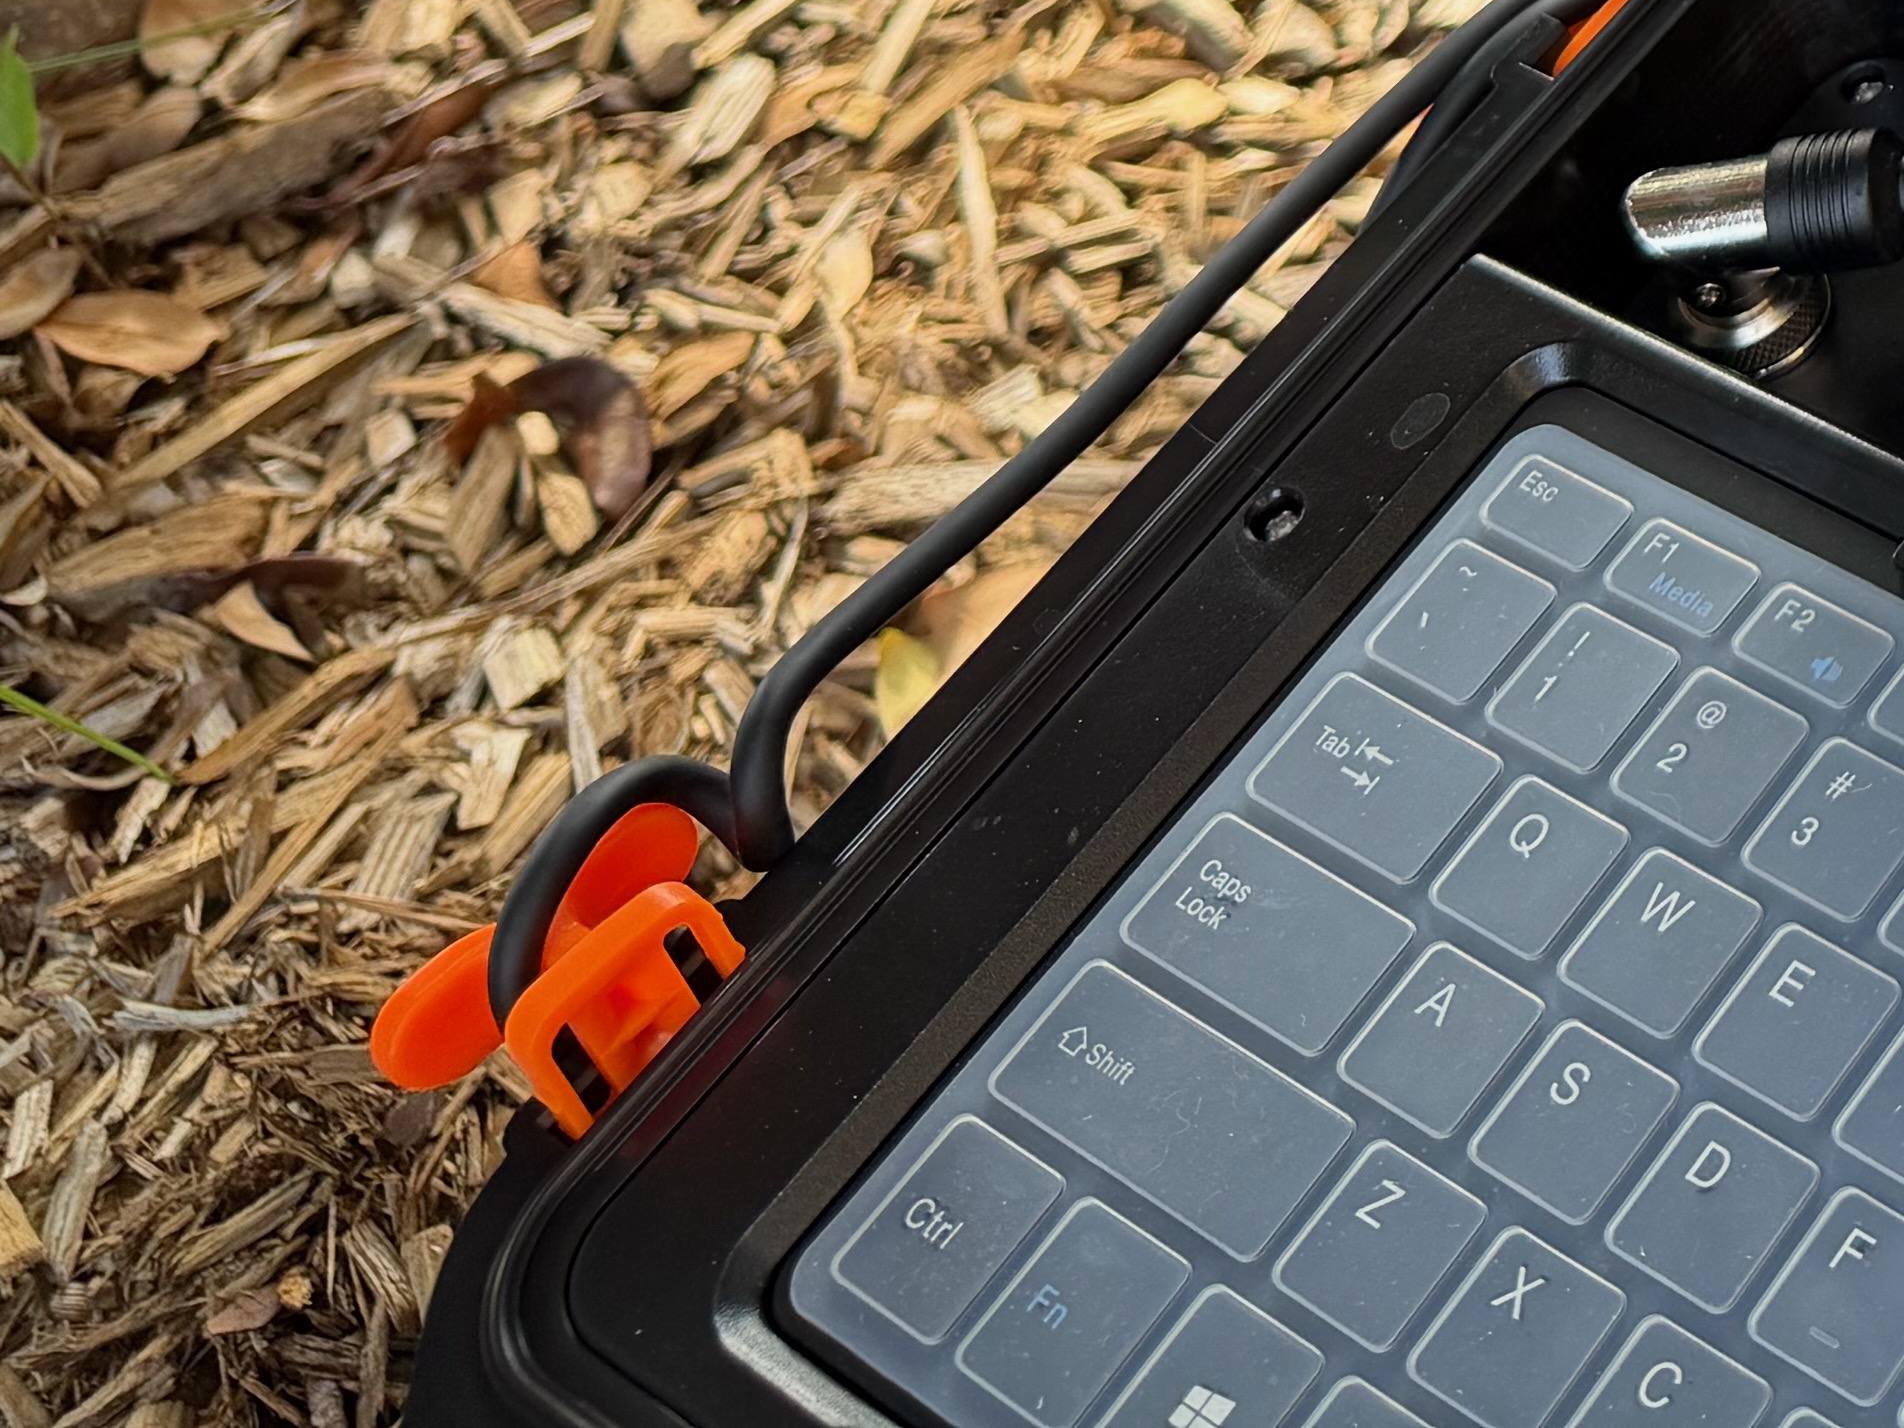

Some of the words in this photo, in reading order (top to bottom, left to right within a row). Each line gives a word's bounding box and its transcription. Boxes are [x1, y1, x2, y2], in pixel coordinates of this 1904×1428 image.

[1518, 468, 1559, 506] Esc
[1644, 532, 1681, 565] F1
[1648, 571, 1715, 620] Media
[1774, 600, 1817, 633] F2
[1567, 631, 1590, 657] !
[1535, 674, 1558, 702] 1
[1698, 699, 1728, 729] @
[1316, 724, 1350, 758] Tab
[1656, 743, 1688, 773] 2
[1824, 771, 1856, 800] #
[1508, 814, 1551, 859] Q
[1791, 817, 1820, 846] 3
[1198, 857, 1252, 906] Caps
[1173, 885, 1229, 931] Lock
[1638, 880, 1696, 933] W
[1413, 982, 1459, 1028] A
[1766, 958, 1817, 1009] E
[1084, 1041, 1137, 1086] Shift
[1548, 1061, 1593, 1105] S
[1684, 1139, 1732, 1190] D
[902, 1196, 965, 1249] Ctrl
[1354, 1178, 1407, 1230] Z
[1827, 1226, 1878, 1270] F
[1025, 1283, 1070, 1331] Fn
[1490, 1265, 1546, 1321] X
[1638, 1361, 1683, 1410] C
